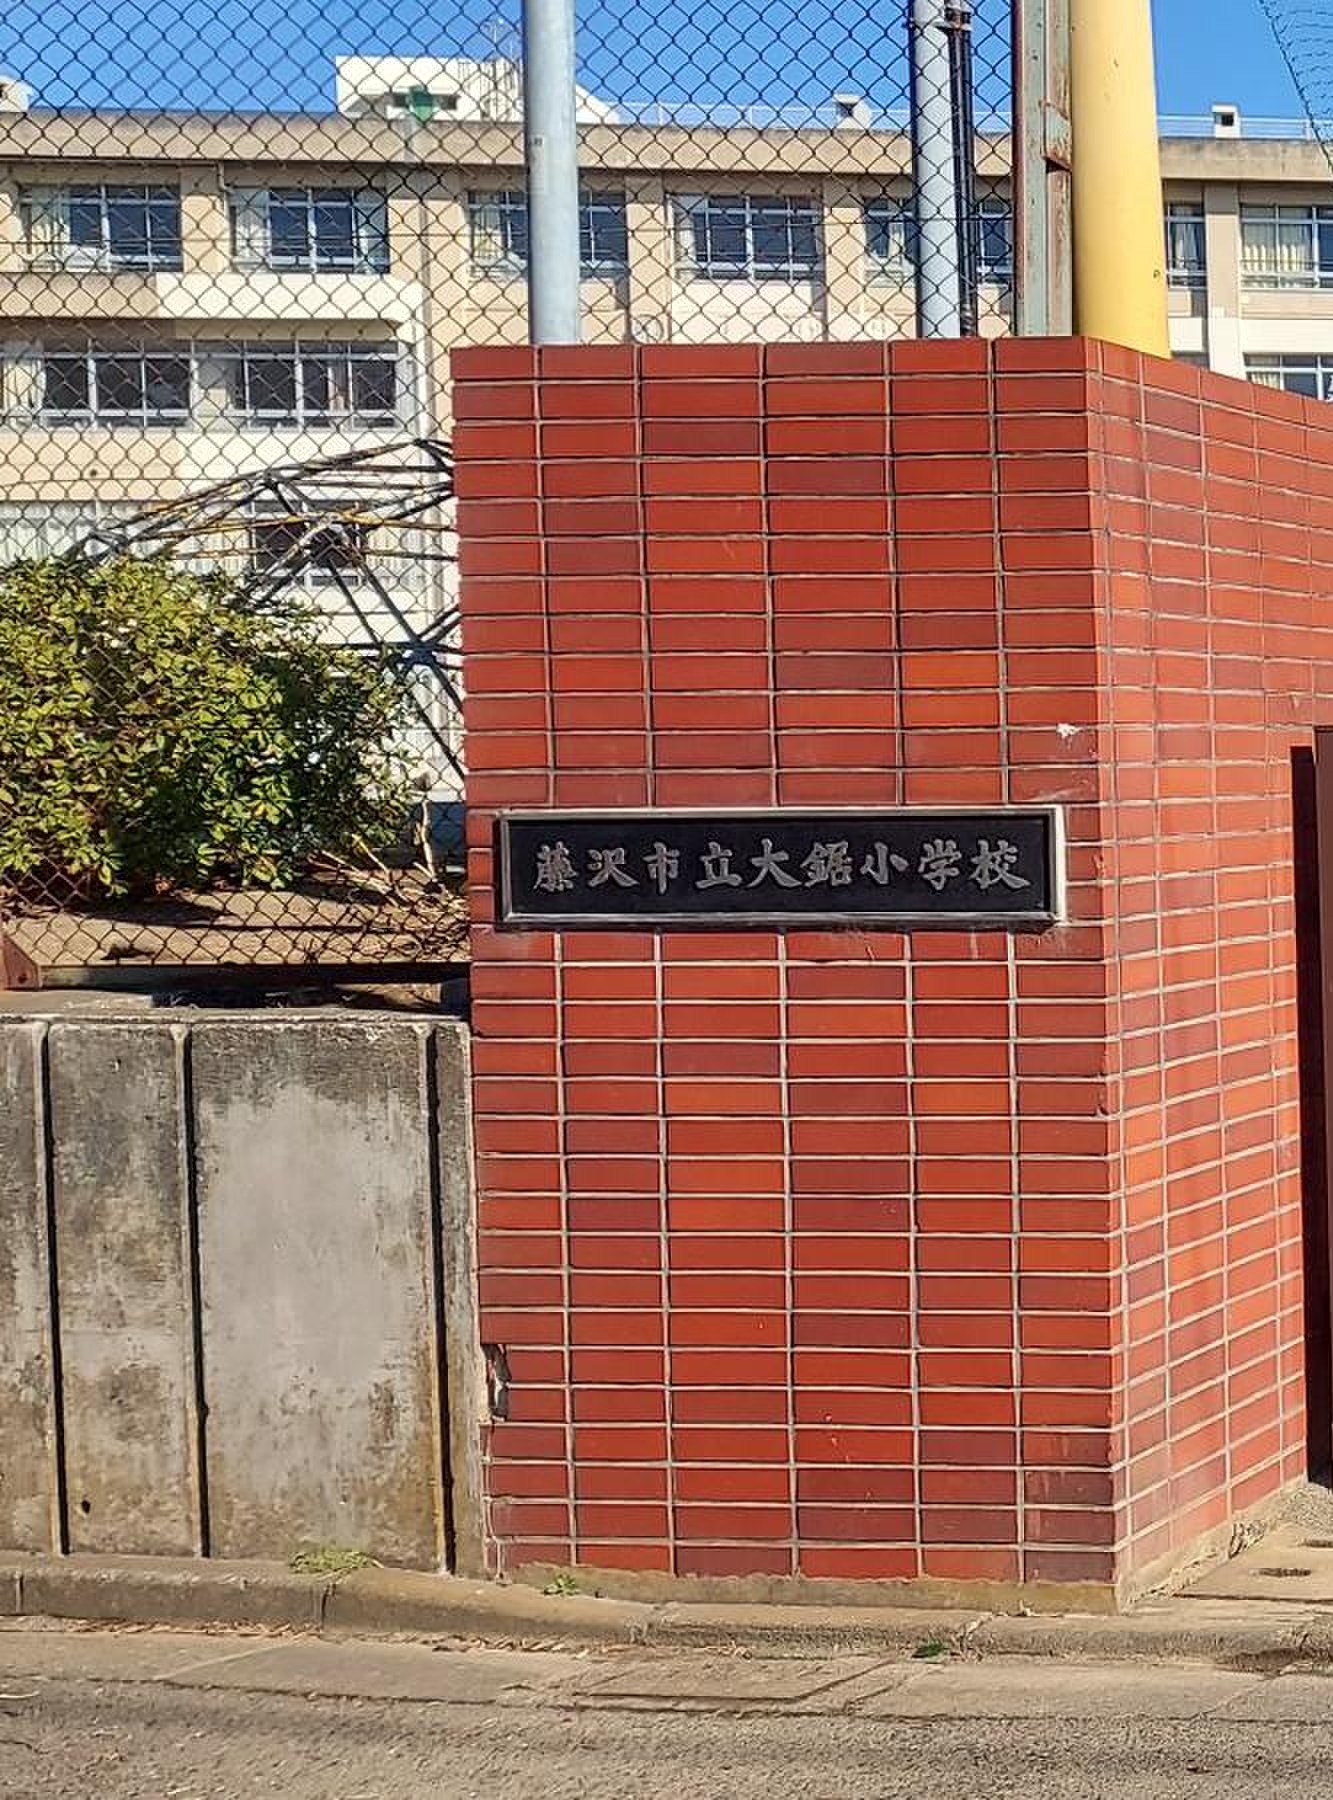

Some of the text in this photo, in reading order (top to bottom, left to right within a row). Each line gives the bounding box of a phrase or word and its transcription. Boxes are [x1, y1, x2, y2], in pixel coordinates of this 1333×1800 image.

[532, 838, 1030, 893] 藤沢市立大鋸小学校
